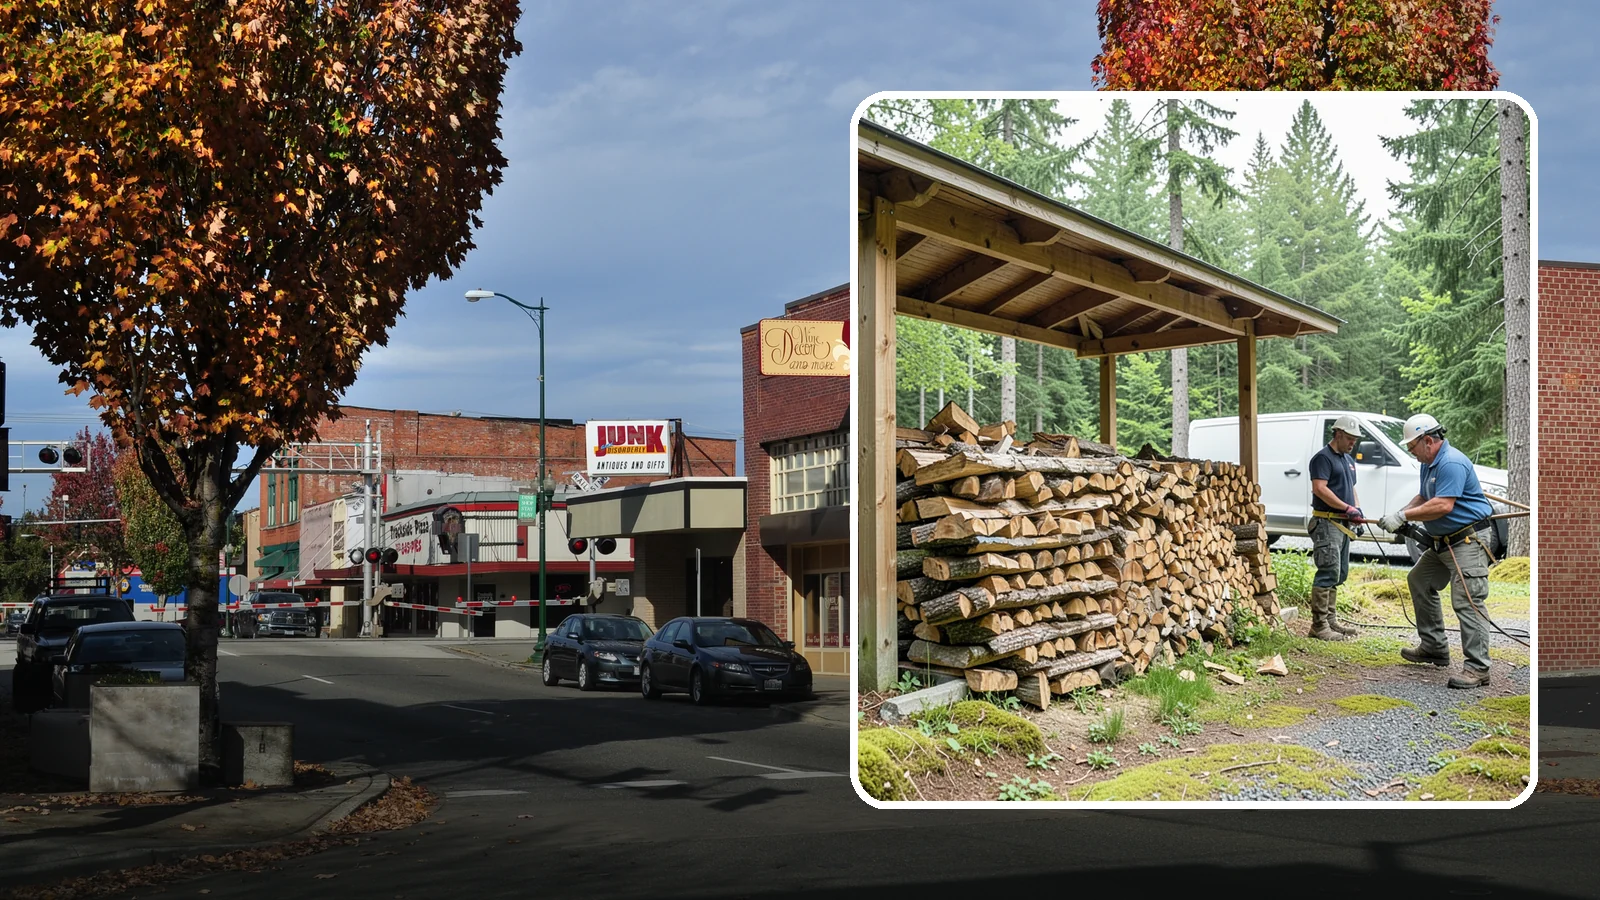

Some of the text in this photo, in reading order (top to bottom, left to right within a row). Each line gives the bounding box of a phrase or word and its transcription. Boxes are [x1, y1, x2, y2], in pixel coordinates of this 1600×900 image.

[765, 328, 830, 365] Decor
[595, 425, 665, 457] JUNK
[607, 446, 646, 454] DISORDERLY
[597, 460, 665, 470] ANTIQUES AND GIFTS
[390, 519, 429, 539] Trackside Pizza
